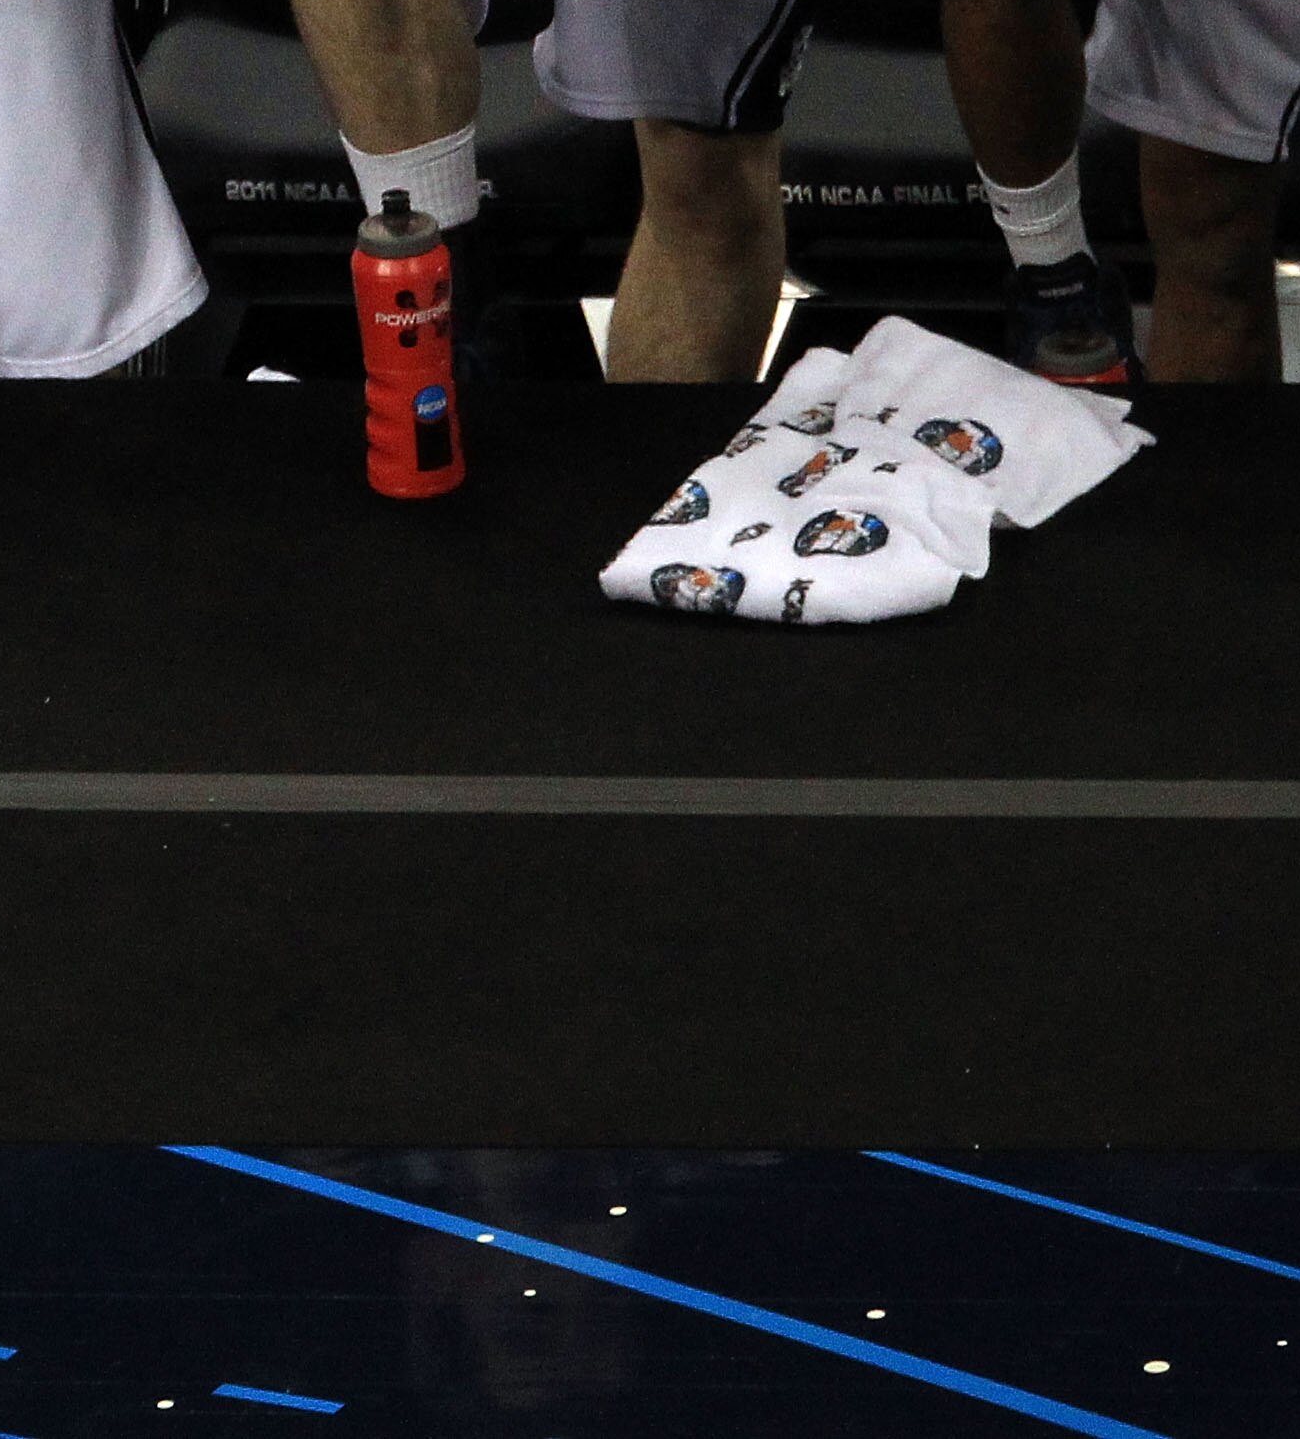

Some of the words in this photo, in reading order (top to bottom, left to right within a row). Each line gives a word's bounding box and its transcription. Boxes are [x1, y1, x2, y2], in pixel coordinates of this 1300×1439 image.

[225, 179, 277, 201] 2011
[285, 180, 350, 202] NCAA
[820, 184, 887, 207] NCAA
[893, 184, 960, 206] FINAL
